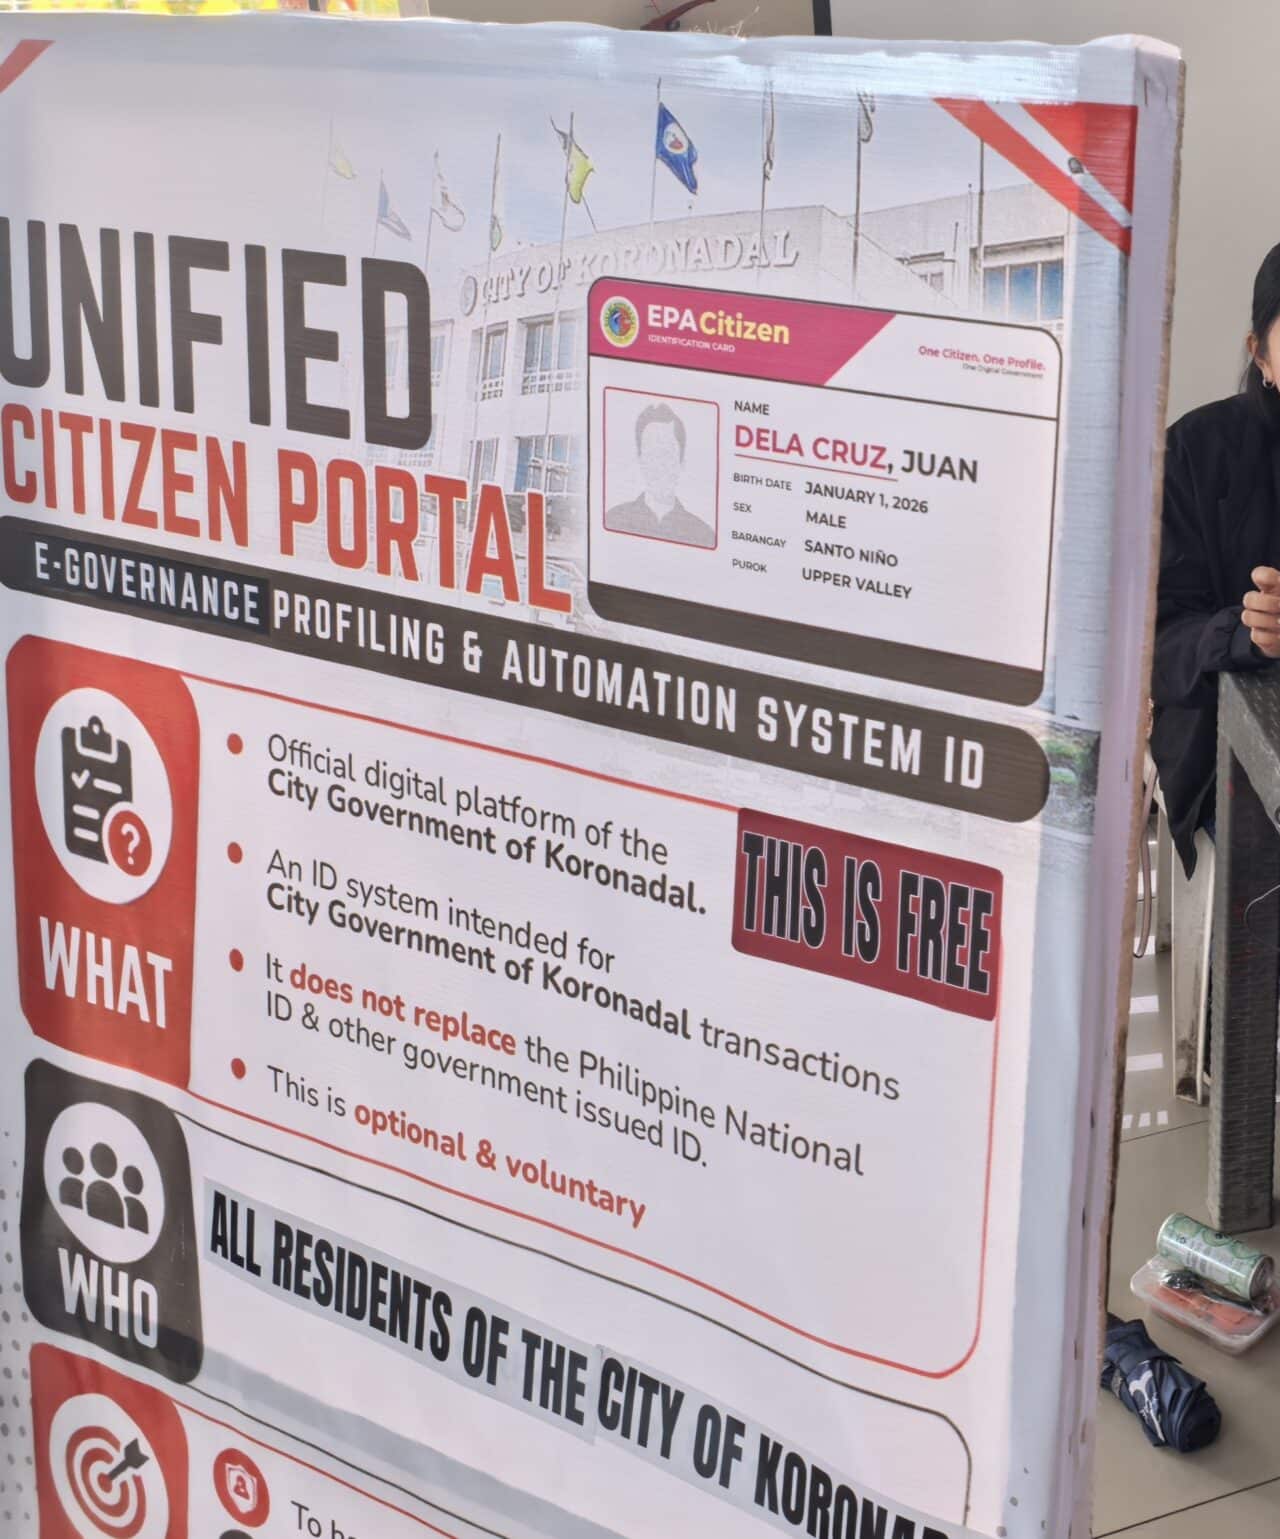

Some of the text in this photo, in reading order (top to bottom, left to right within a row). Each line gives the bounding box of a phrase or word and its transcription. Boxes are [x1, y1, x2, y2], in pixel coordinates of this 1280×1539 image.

[575, 230, 799, 288] KORONADAL
[0, 217, 431, 450] UNIFIED
[648, 334, 736, 353] IDENTIFICATION CARD
[918, 346, 940, 358] One
[983, 354, 1005, 366] One
[1008, 357, 1046, 371] Profile.
[962, 363, 977, 371] One
[734, 400, 770, 415] NAME
[733, 472, 793, 491] BIRTH DATE
[735, 424, 978, 483] DELA CRUZ, JUAN
[2, 402, 571, 613] CITIZEN PORTAL
[733, 502, 752, 513] SEX
[805, 481, 929, 513] JANUARY 1, 2026
[806, 510, 847, 529] MALE
[731, 530, 786, 548] BARANGAY
[732, 559, 767, 573] PUROK
[804, 539, 898, 567] SANTO NIÑO
[802, 568, 912, 599] UPPER VALLEY
[34, 541, 985, 789] E-GOVERNANCE PROFILING & AUTOMATION SYSTEM ID
[268, 734, 668, 866] Official digital platform of the
[268, 767, 707, 915] City Government of Koronadal.
[267, 849, 615, 974] An ID system intended for
[742, 831, 993, 995] THIS IS FREE
[39, 916, 173, 1028] WHAT
[266, 882, 900, 1101] City Government of Koronadal transactions
[266, 953, 864, 1176] It does not replace the Philippine National
[266, 991, 707, 1167] ID & other government issued ID.
[267, 1066, 646, 1228] This is optional & voluntary
[58, 1248, 158, 1350] WHO
[210, 1191, 262, 1277] ALL
[272, 1219, 454, 1362] RESIDENTS
[462, 1307, 510, 1386] OF
[521, 1328, 588, 1426] THE
[597, 1357, 684, 1460] CITY
[693, 1404, 746, 1489] OF
[291, 1500, 322, 1538] To
